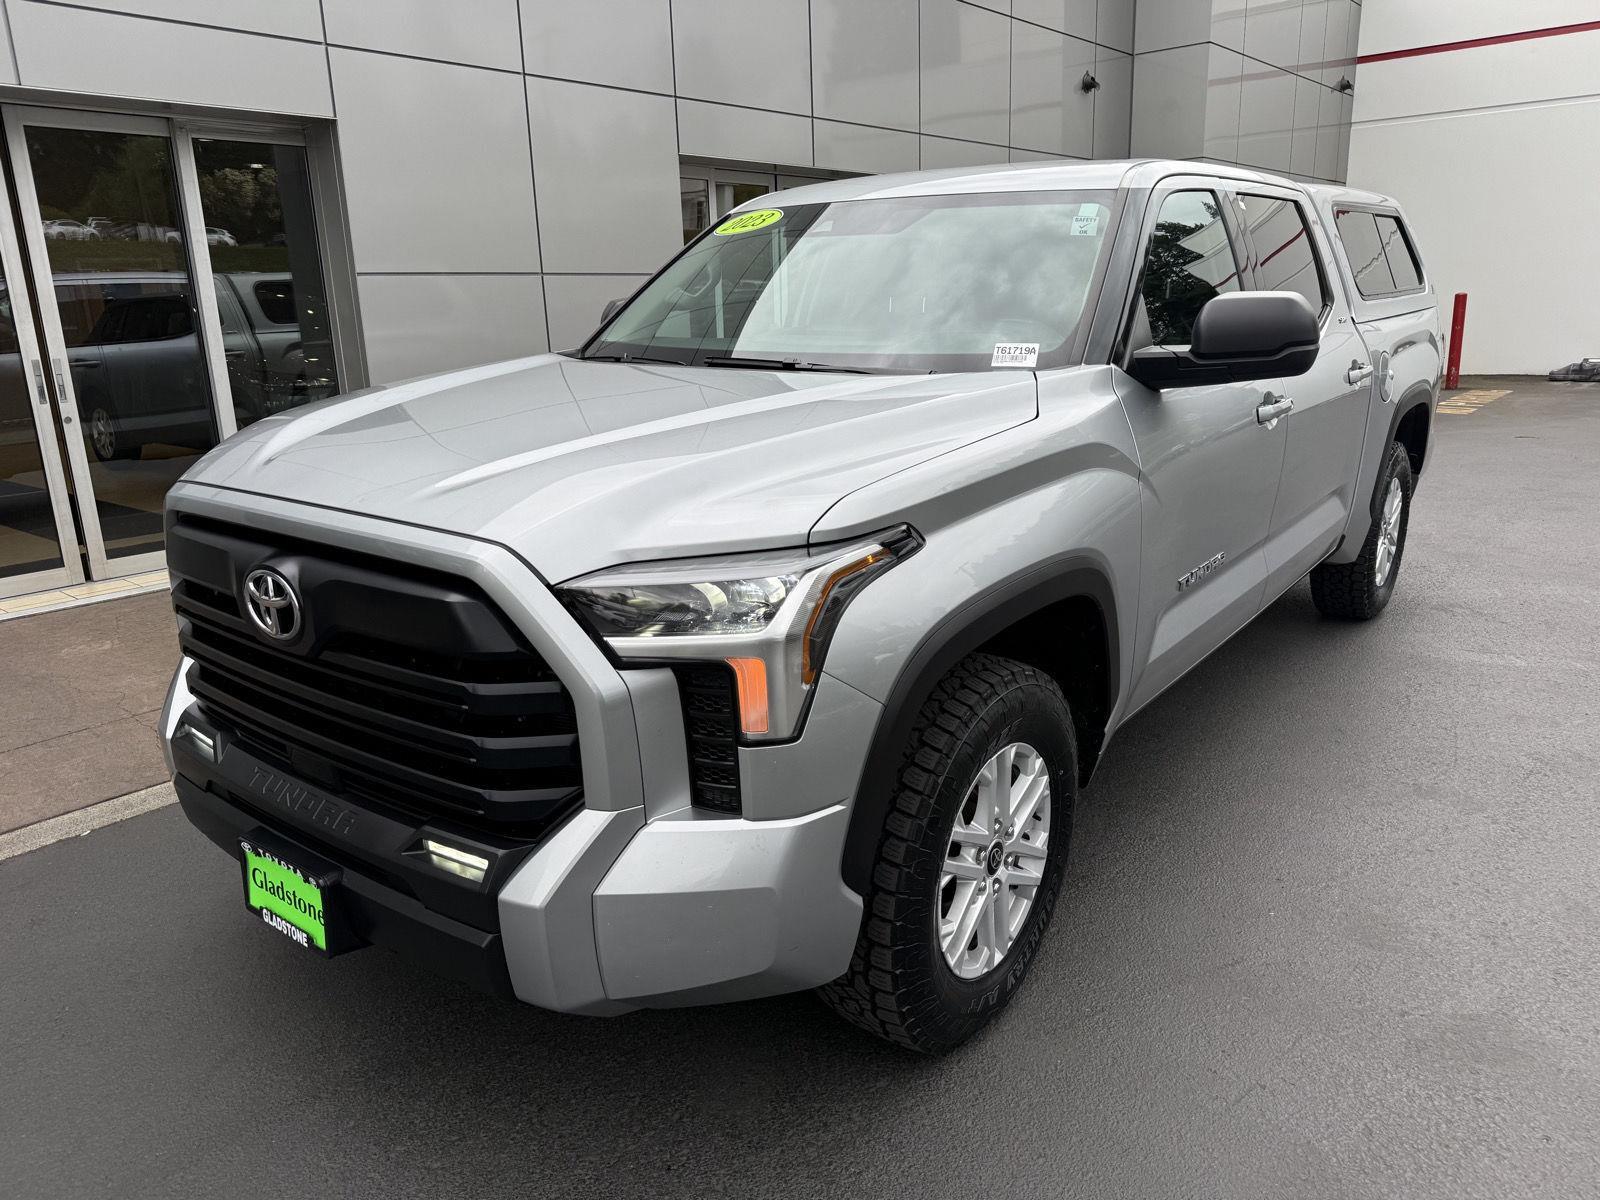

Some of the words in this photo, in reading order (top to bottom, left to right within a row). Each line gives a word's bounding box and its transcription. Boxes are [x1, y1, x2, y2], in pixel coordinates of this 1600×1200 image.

[720, 213, 775, 232] 2023
[996, 346, 1036, 355] T61719A
[1177, 551, 1225, 592] TUNDRA
[249, 766, 357, 835] TUNDRA
[252, 866, 325, 927] Gladstone
[262, 908, 309, 948] GLADSTONE
